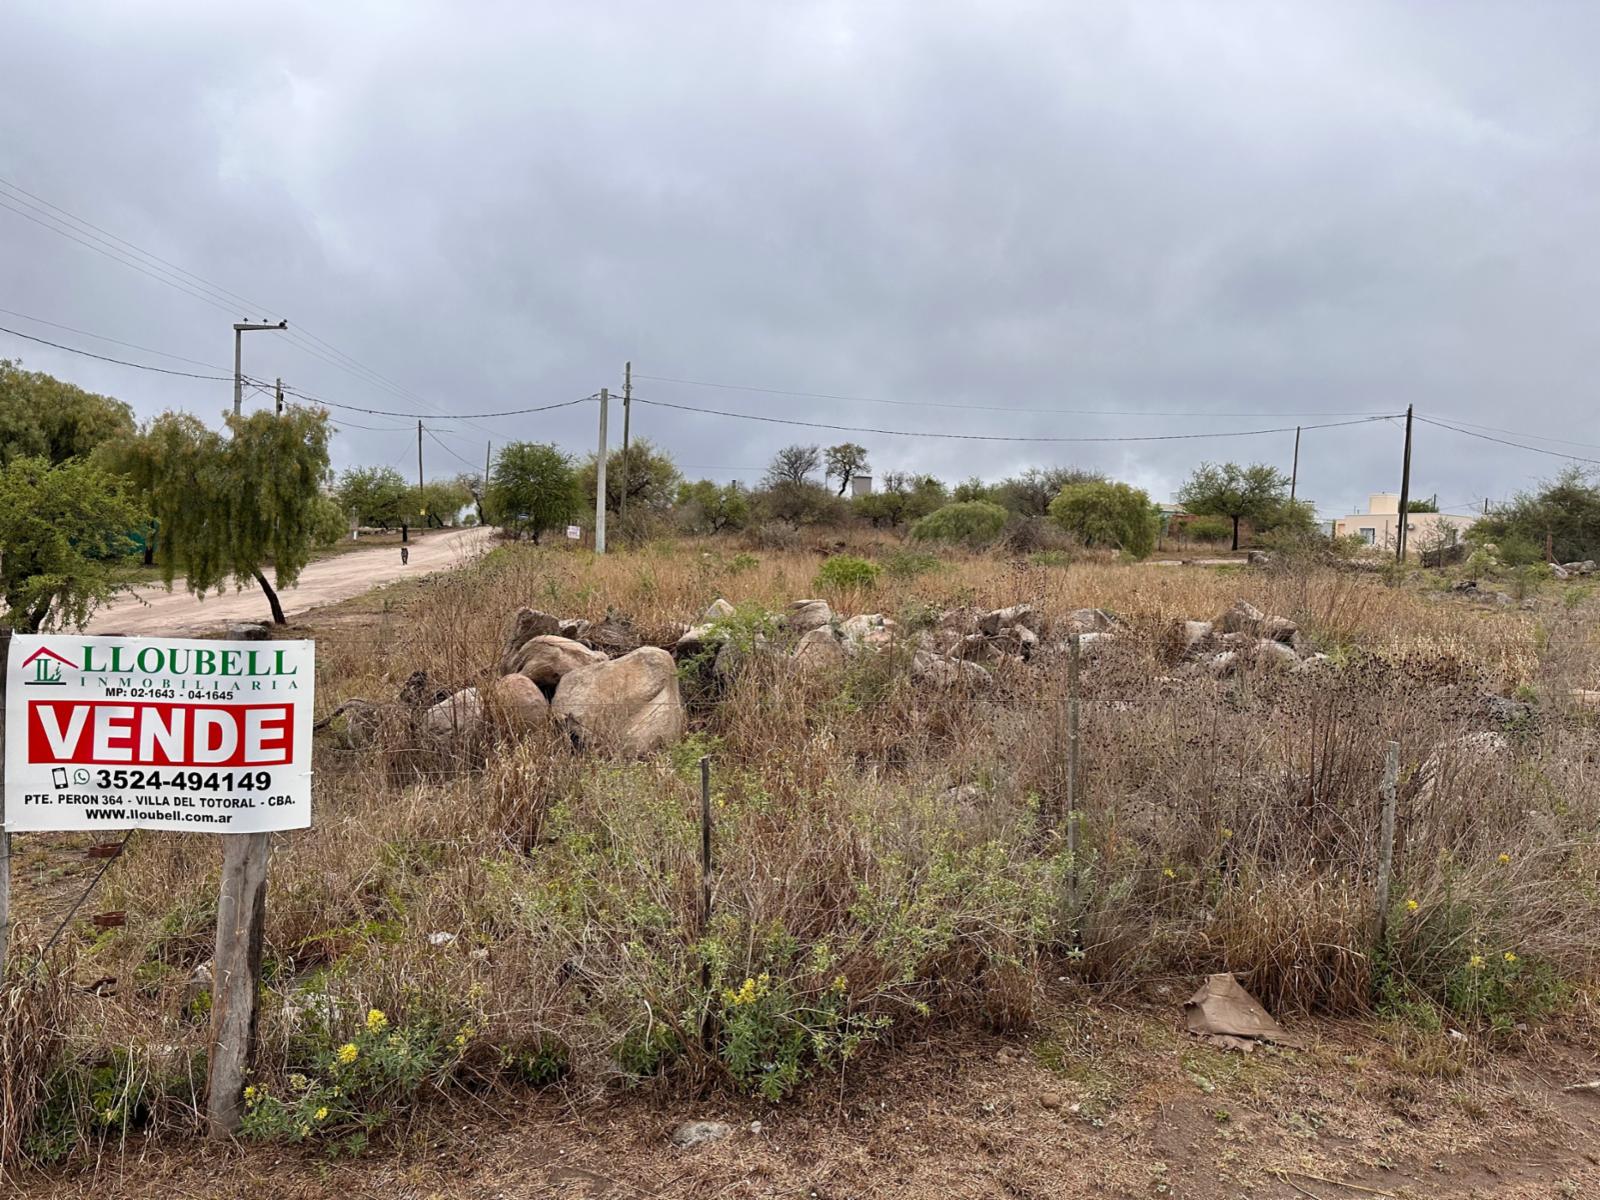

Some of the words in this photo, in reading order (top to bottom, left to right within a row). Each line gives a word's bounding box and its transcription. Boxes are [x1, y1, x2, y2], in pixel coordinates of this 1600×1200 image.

[80, 645, 298, 676] LLOUBELL
[80, 676, 298, 691] INMOBILIARIA
[105, 687, 127, 698] MP:
[130, 688, 175, 699] 02-1643
[188, 690, 234, 701] 04-1645
[35, 705, 286, 763] VENDE
[96, 769, 272, 792] 3524-494149
[24, 794, 53, 805] PTE.
[58, 794, 99, 805] PERON
[102, 795, 123, 806] 364
[135, 796, 170, 807] VILLA
[174, 797, 196, 808] DEL
[200, 798, 256, 808] TOTORAL
[268, 796, 296, 806] CBA.
